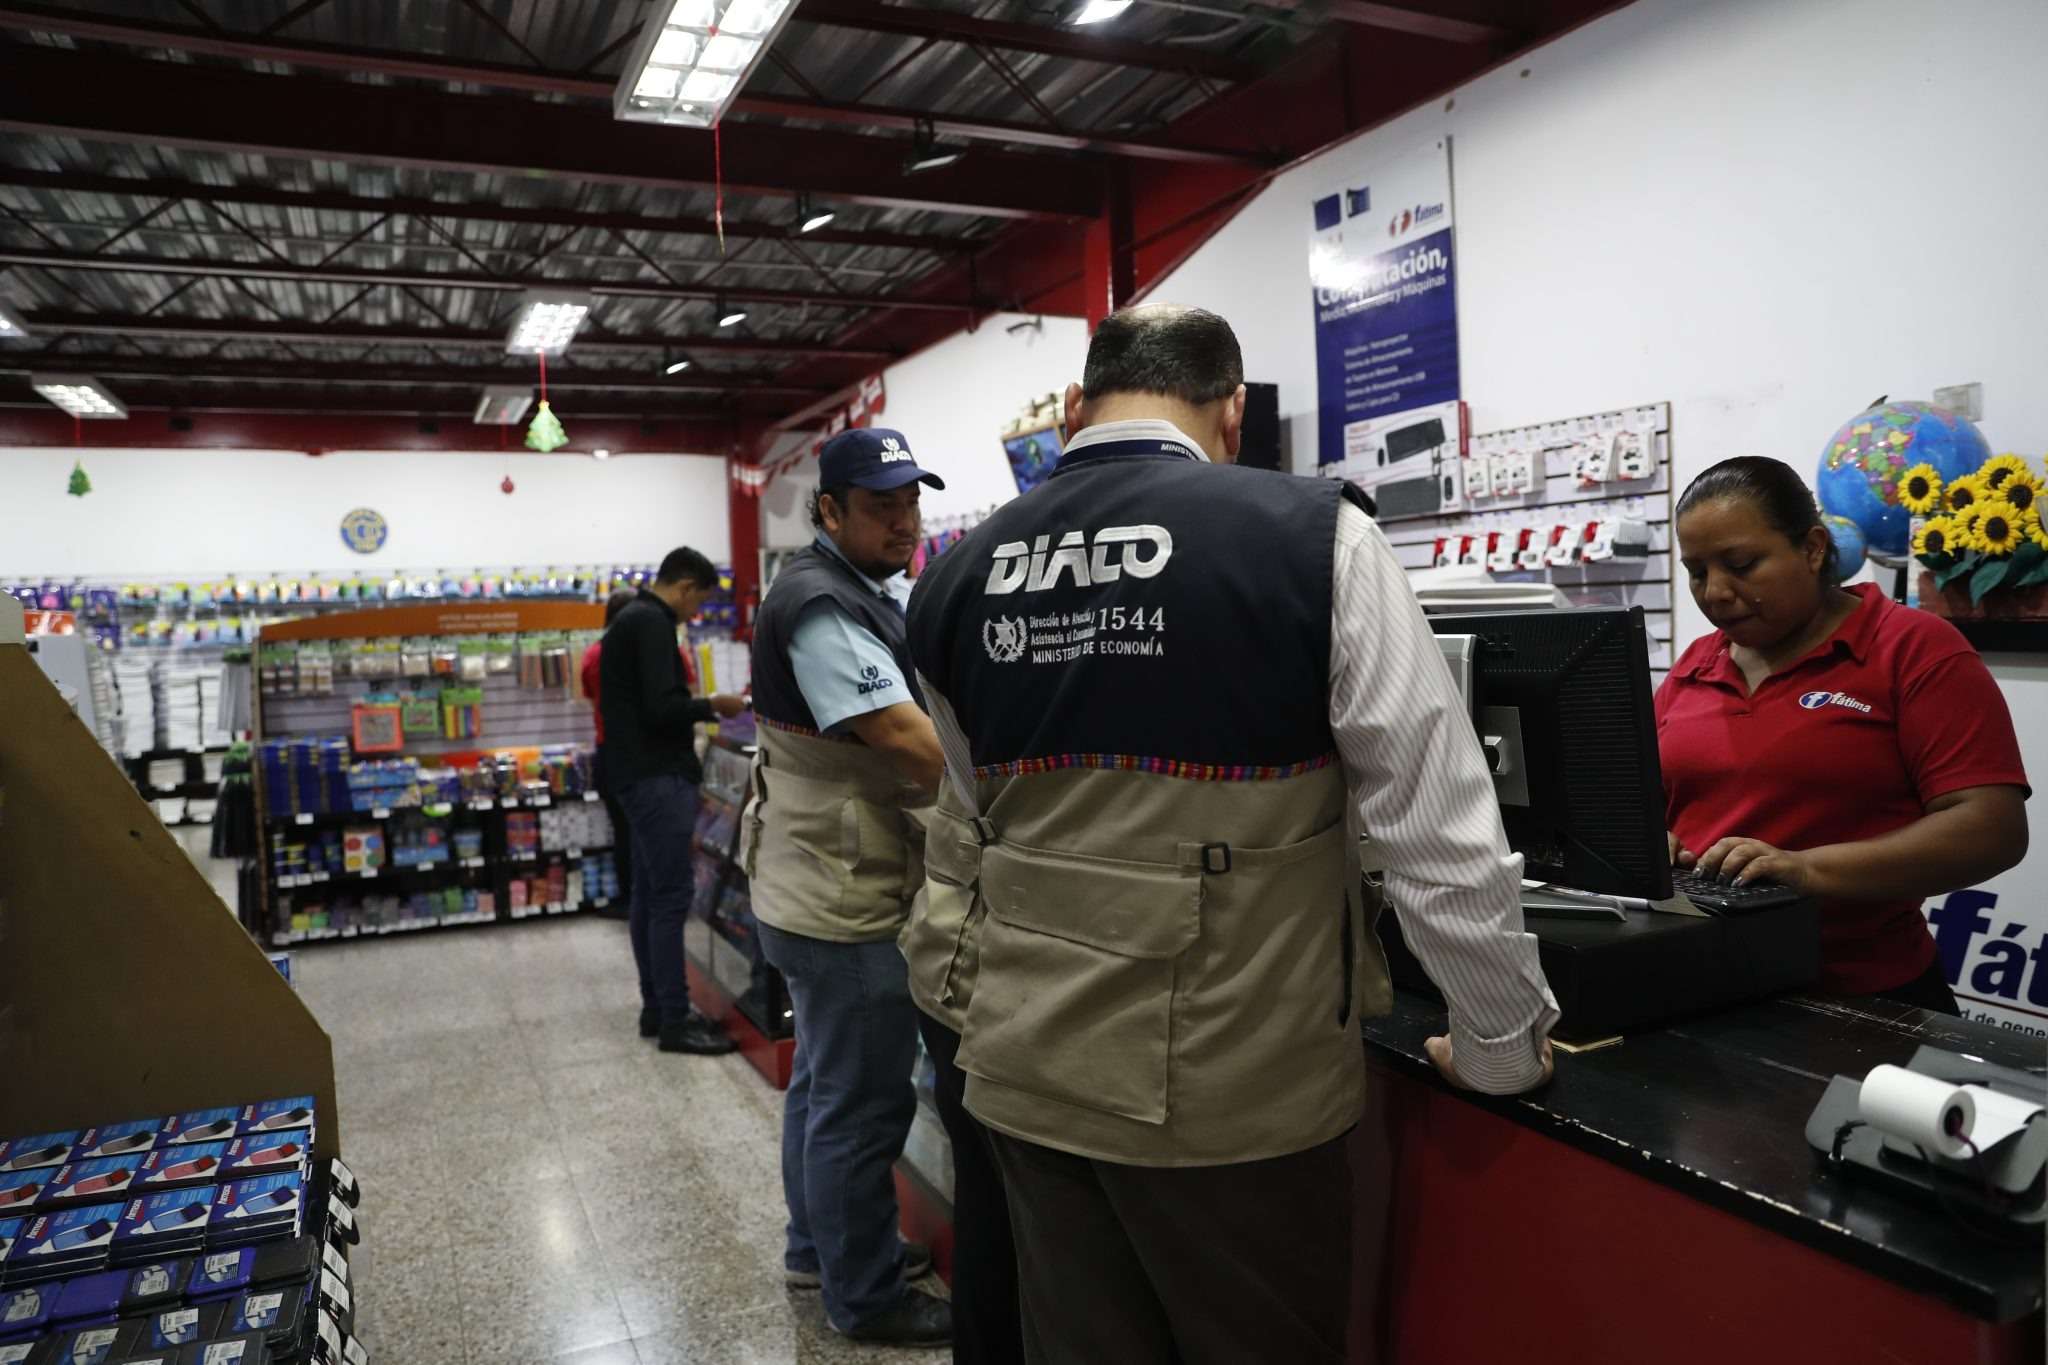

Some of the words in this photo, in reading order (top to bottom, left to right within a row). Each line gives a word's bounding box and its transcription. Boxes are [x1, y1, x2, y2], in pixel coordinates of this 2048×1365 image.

[984, 524, 1173, 594] DIACO
[1098, 606, 1165, 631] 1544
[1082, 641, 1095, 655] DE
[1100, 637, 1164, 656] ECONOMÍA
[857, 679, 893, 695] DIACO
